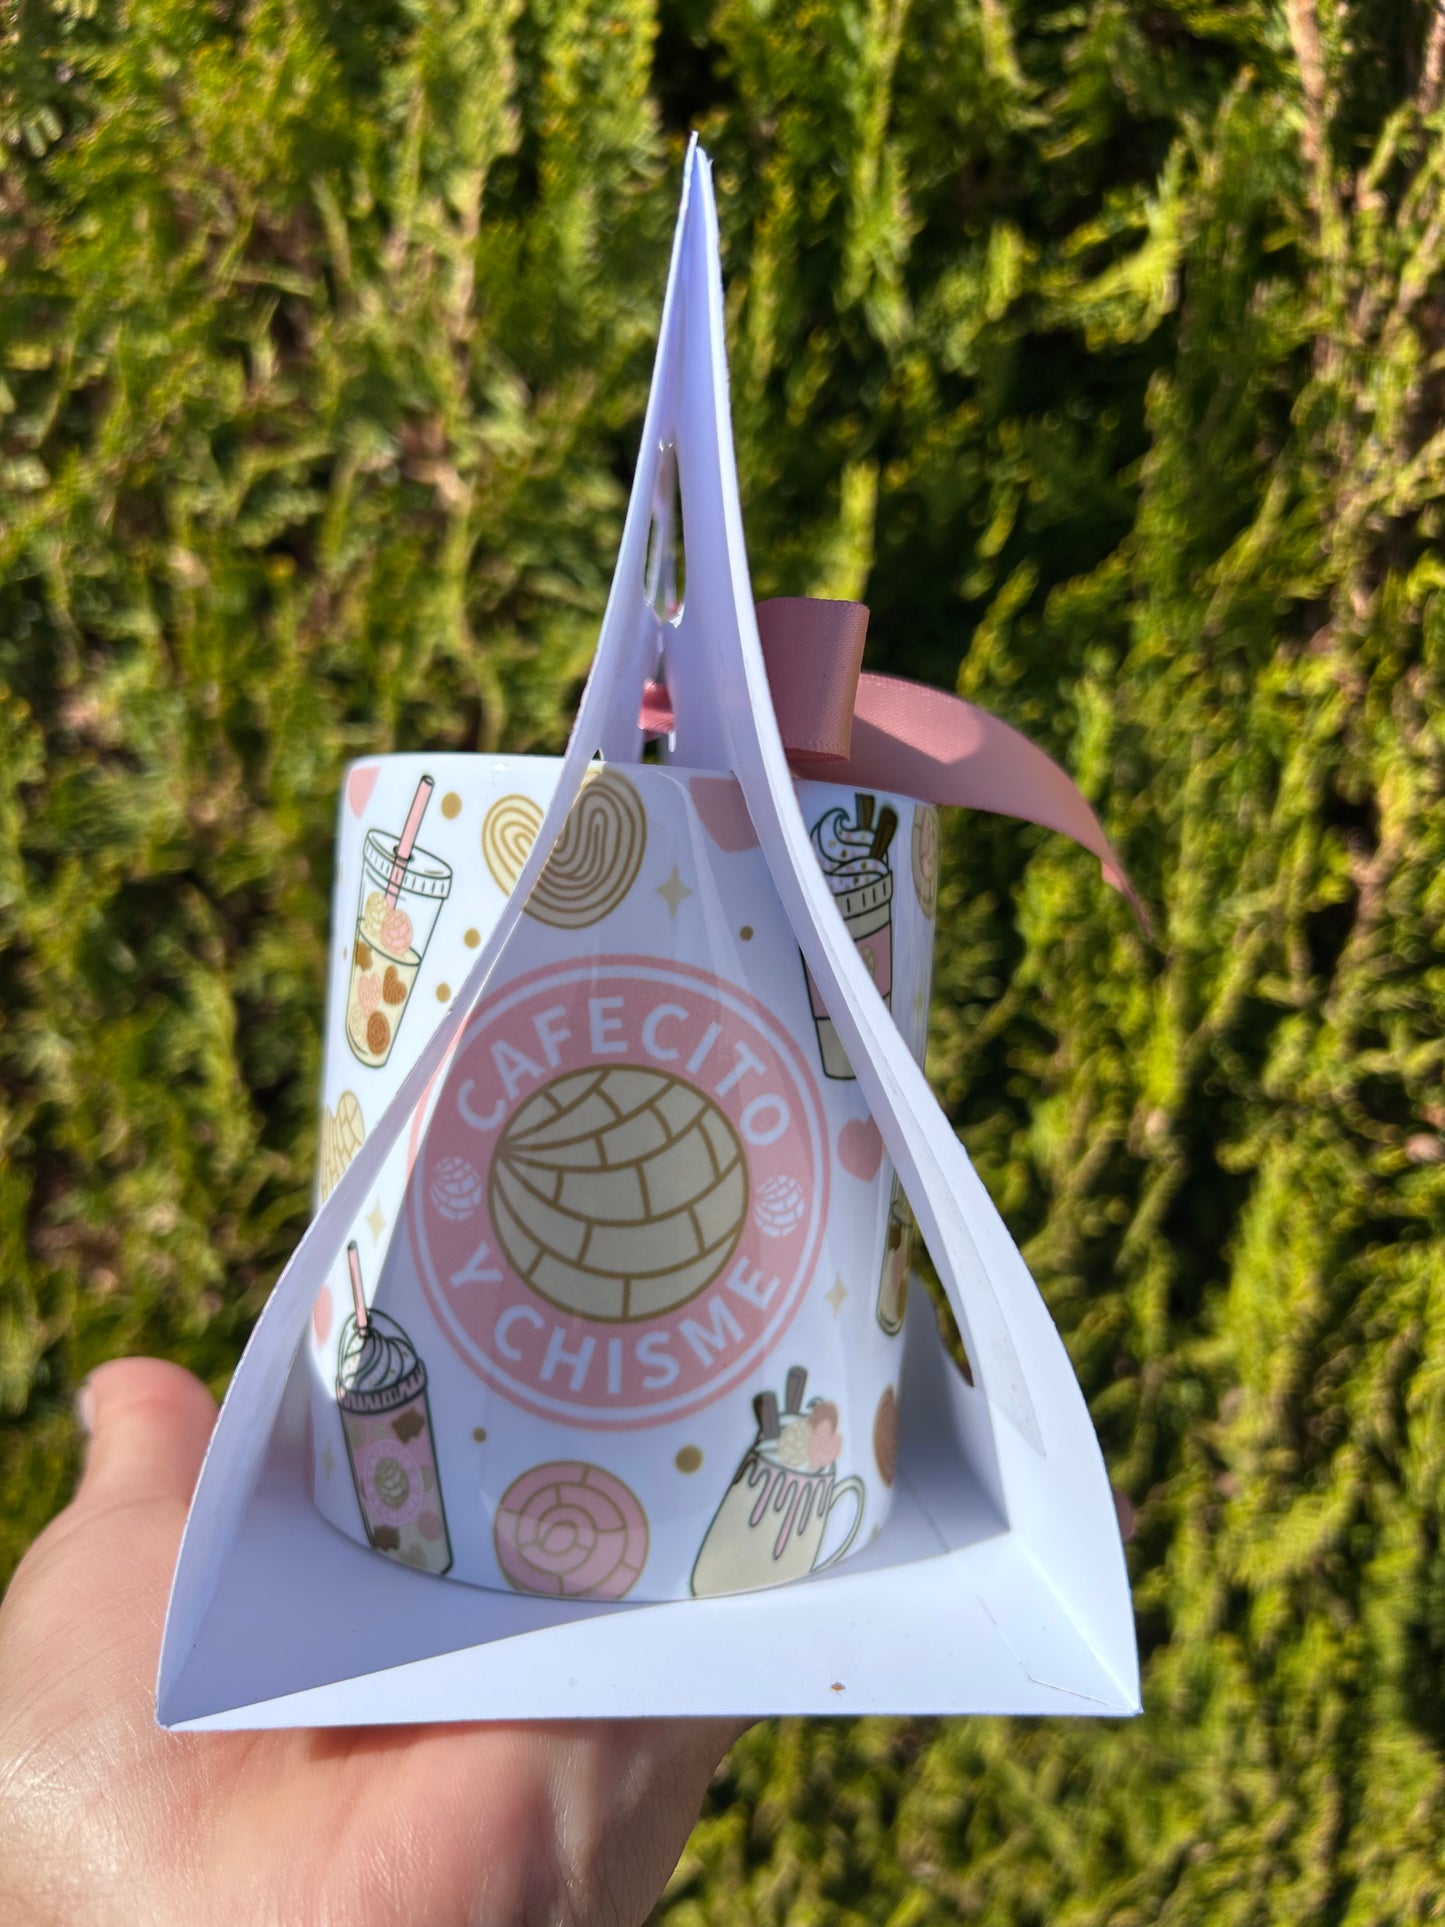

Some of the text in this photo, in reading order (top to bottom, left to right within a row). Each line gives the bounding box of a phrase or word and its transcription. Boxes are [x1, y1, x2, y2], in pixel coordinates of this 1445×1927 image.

[457, 996, 791, 1146] CAFECITO
[450, 1245, 780, 1394] Y CHISME
